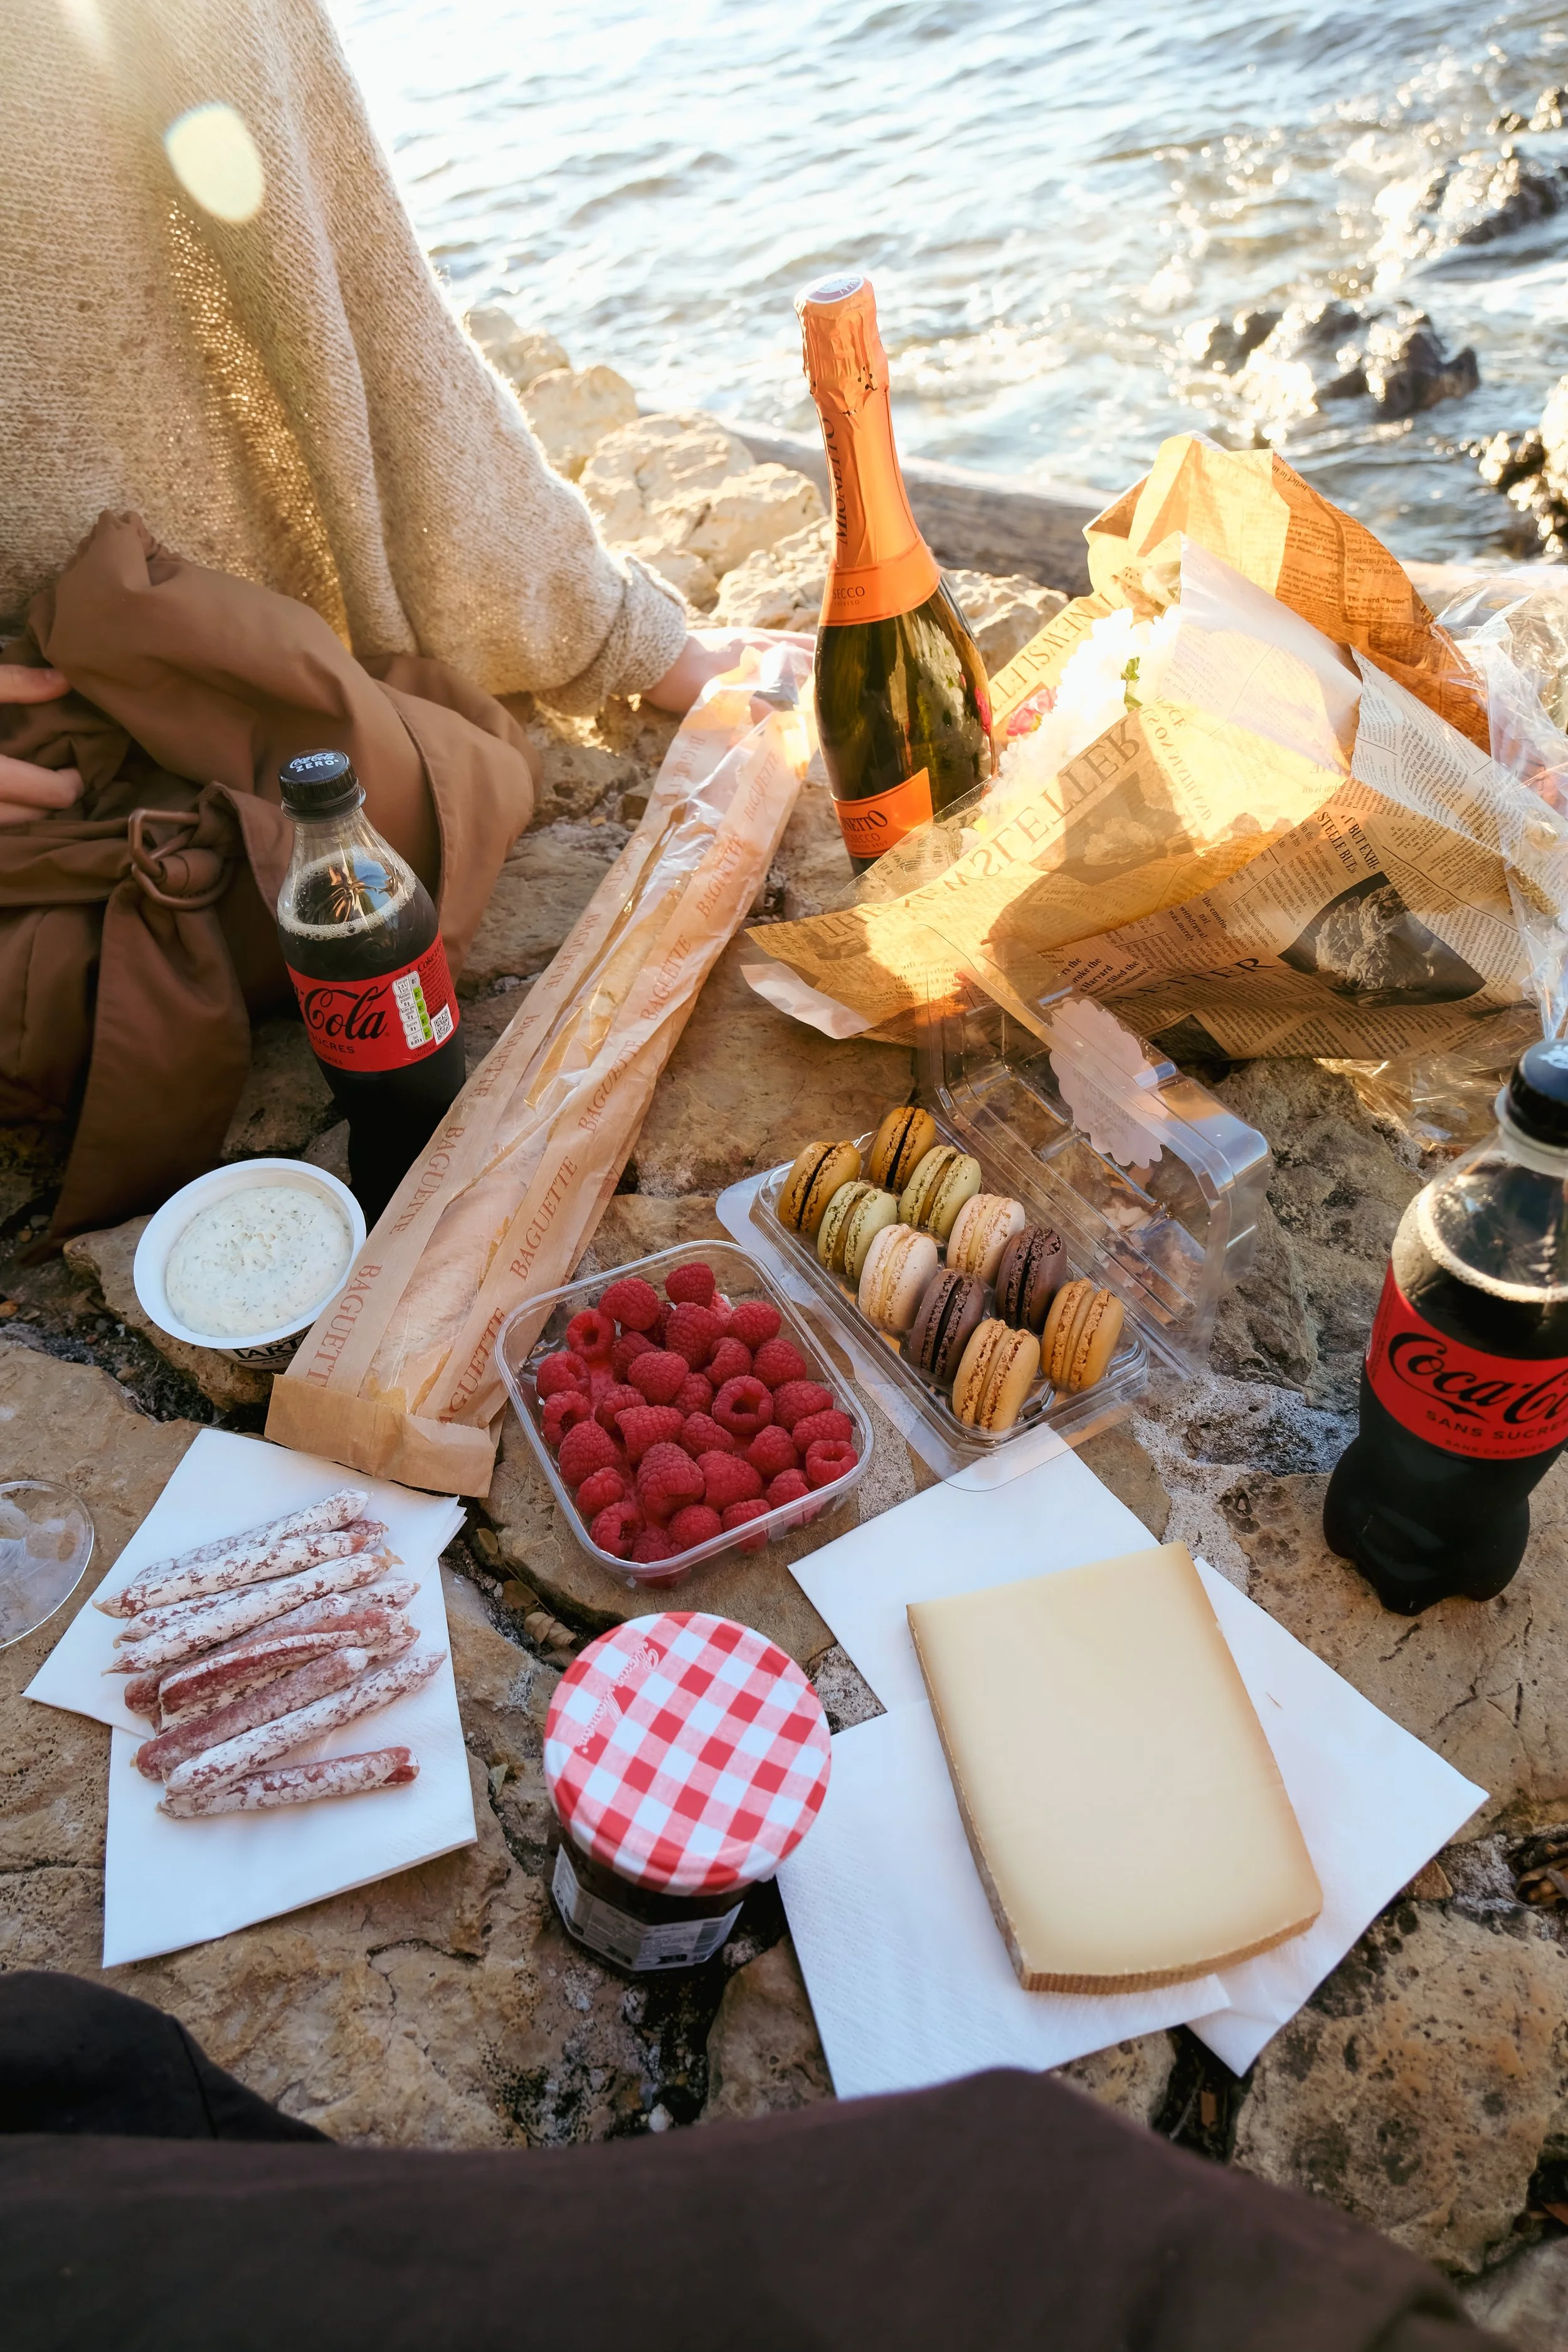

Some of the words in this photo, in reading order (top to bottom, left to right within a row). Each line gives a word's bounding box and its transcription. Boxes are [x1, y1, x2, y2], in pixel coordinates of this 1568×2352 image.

[822, 417, 849, 548] MIONETTO
[832, 586, 865, 600] SECCO
[295, 760, 335, 773] ZERO
[842, 810, 888, 832] NETTO
[1300, 824, 1311, 834] in
[1315, 810, 1348, 853] STEELE
[847, 832, 881, 844] OSECCO
[1291, 836, 1303, 847] his
[1304, 830, 1316, 842] the
[1346, 822, 1368, 847] BUT
[1357, 841, 1382, 872] EXHI-
[1167, 909, 1180, 923] was
[1175, 919, 1197, 944] merely
[1178, 903, 1209, 941] withdrawal
[1199, 911, 1210, 924] nal
[1202, 895, 1214, 909] the
[1209, 906, 1231, 931] emotio-
[1248, 908, 1266, 929] Stallman
[1263, 926, 1279, 945] viewed
[1249, 924, 1261, 936] with
[1067, 955, 1082, 969] the
[1082, 962, 1113, 989] Harvard
[1087, 955, 1101, 970] the
[1108, 968, 1127, 985] filled
[1125, 958, 1140, 972] the
[577, 1039, 645, 1135] BAGUETTE
[388, 1125, 467, 1236] BAGUETTE
[509, 1155, 580, 1282] BAGUETTE
[305, 1262, 383, 1389] BAGUETT
[231, 1332, 307, 1360] TART
[440, 1306, 506, 1424] AGUETTE
[1426, 1410, 1483, 1437] SANS
[1492, 1417, 1568, 1441] SUCRES
